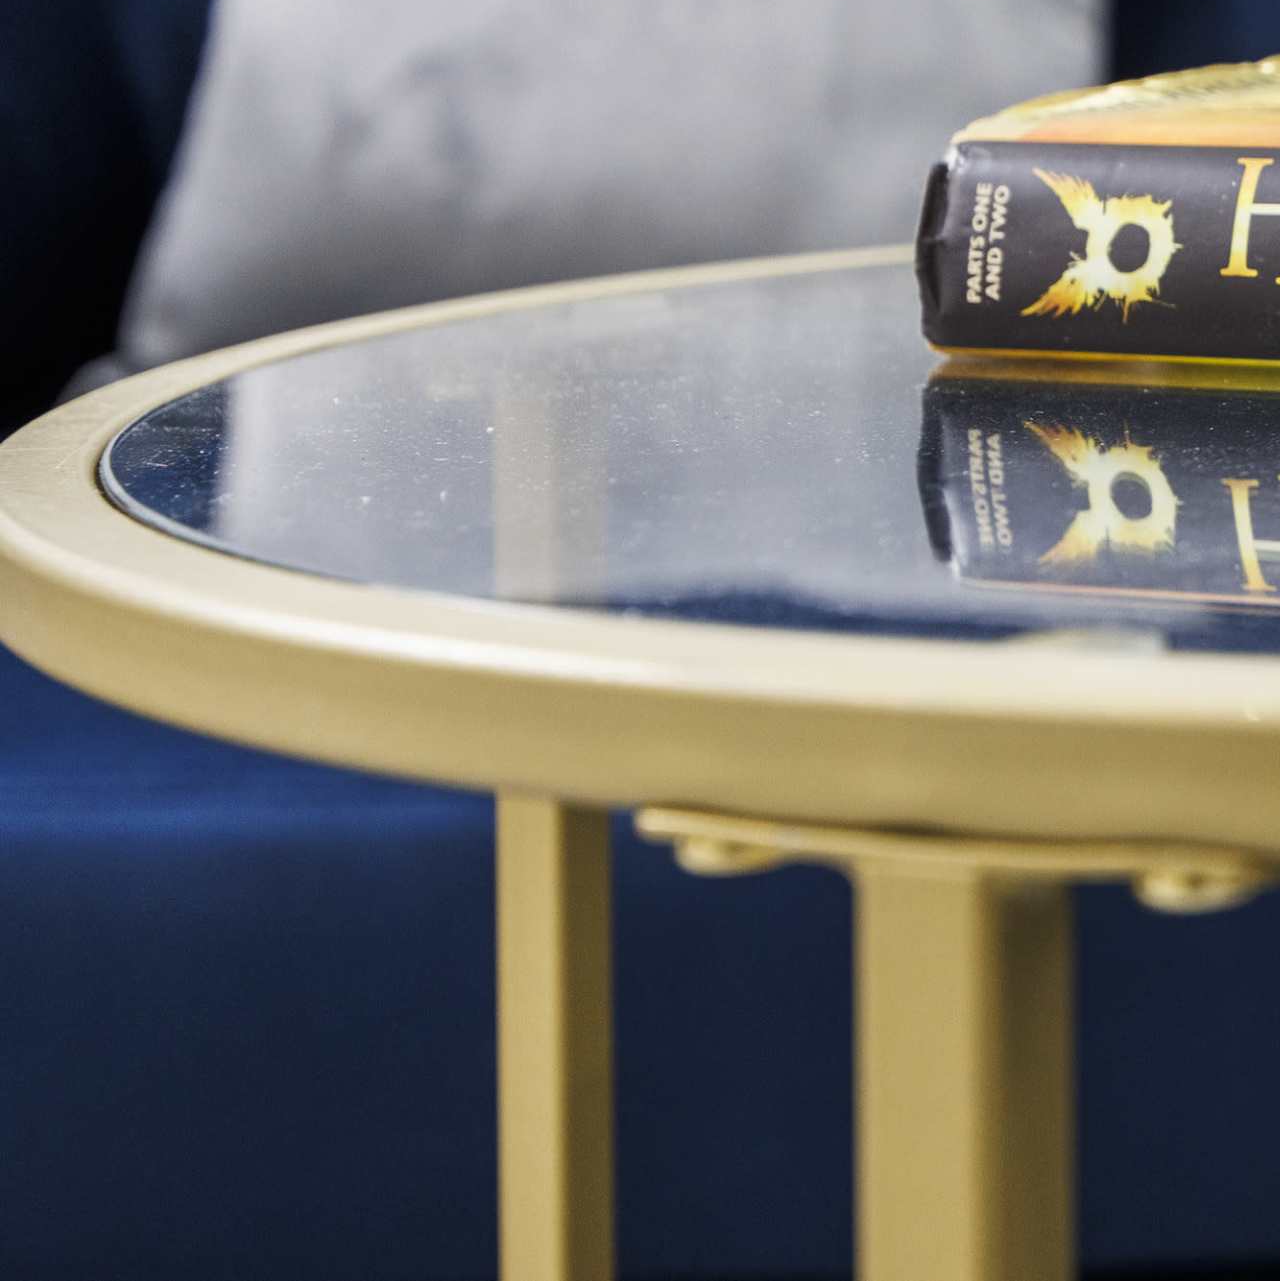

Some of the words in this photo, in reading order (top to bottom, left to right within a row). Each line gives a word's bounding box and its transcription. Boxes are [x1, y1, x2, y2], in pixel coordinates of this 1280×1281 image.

[971, 182, 993, 232] ONE
[988, 184, 1010, 243] TWO
[966, 235, 985, 303] PARTS
[985, 247, 1003, 301] AND
